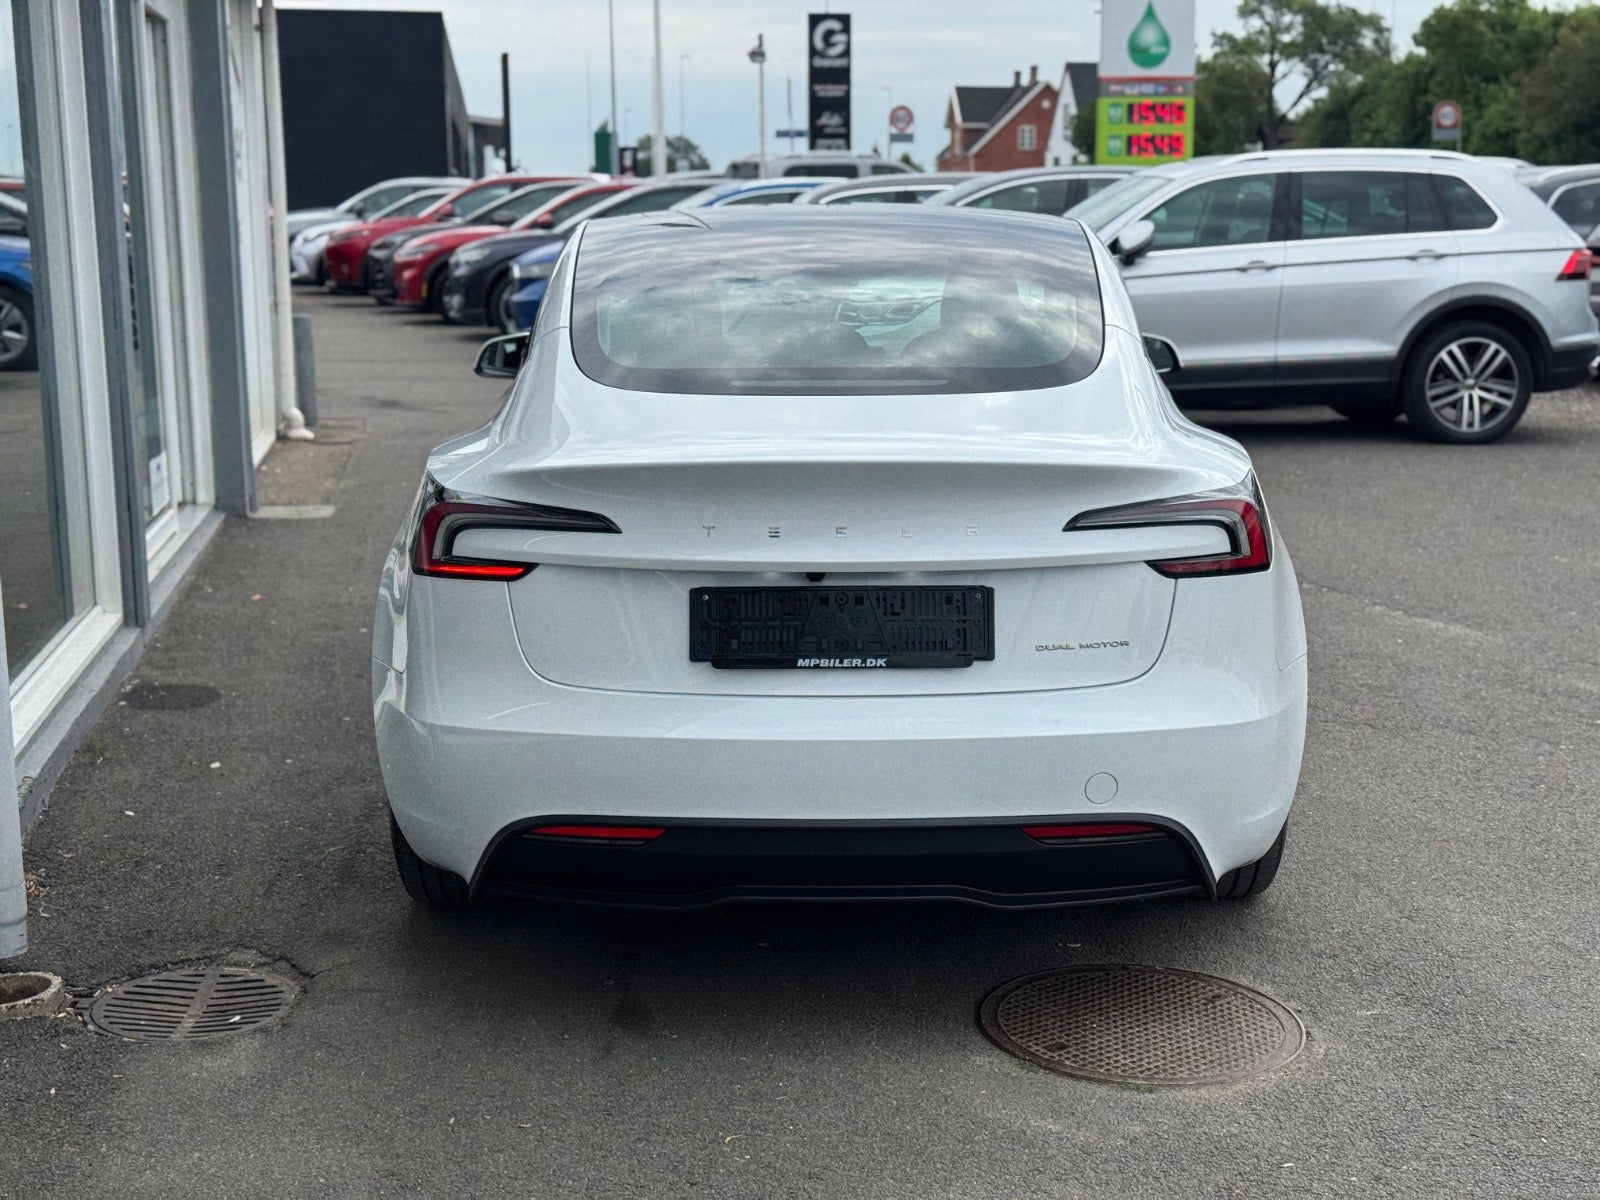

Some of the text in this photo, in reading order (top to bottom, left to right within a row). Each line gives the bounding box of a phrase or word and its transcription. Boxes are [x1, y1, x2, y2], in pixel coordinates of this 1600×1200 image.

[813, 18, 848, 57] G
[702, 525, 980, 538] TESLA
[1035, 640, 1131, 652] DUAL MOTOR
[796, 658, 888, 669] MPBILER.DK
